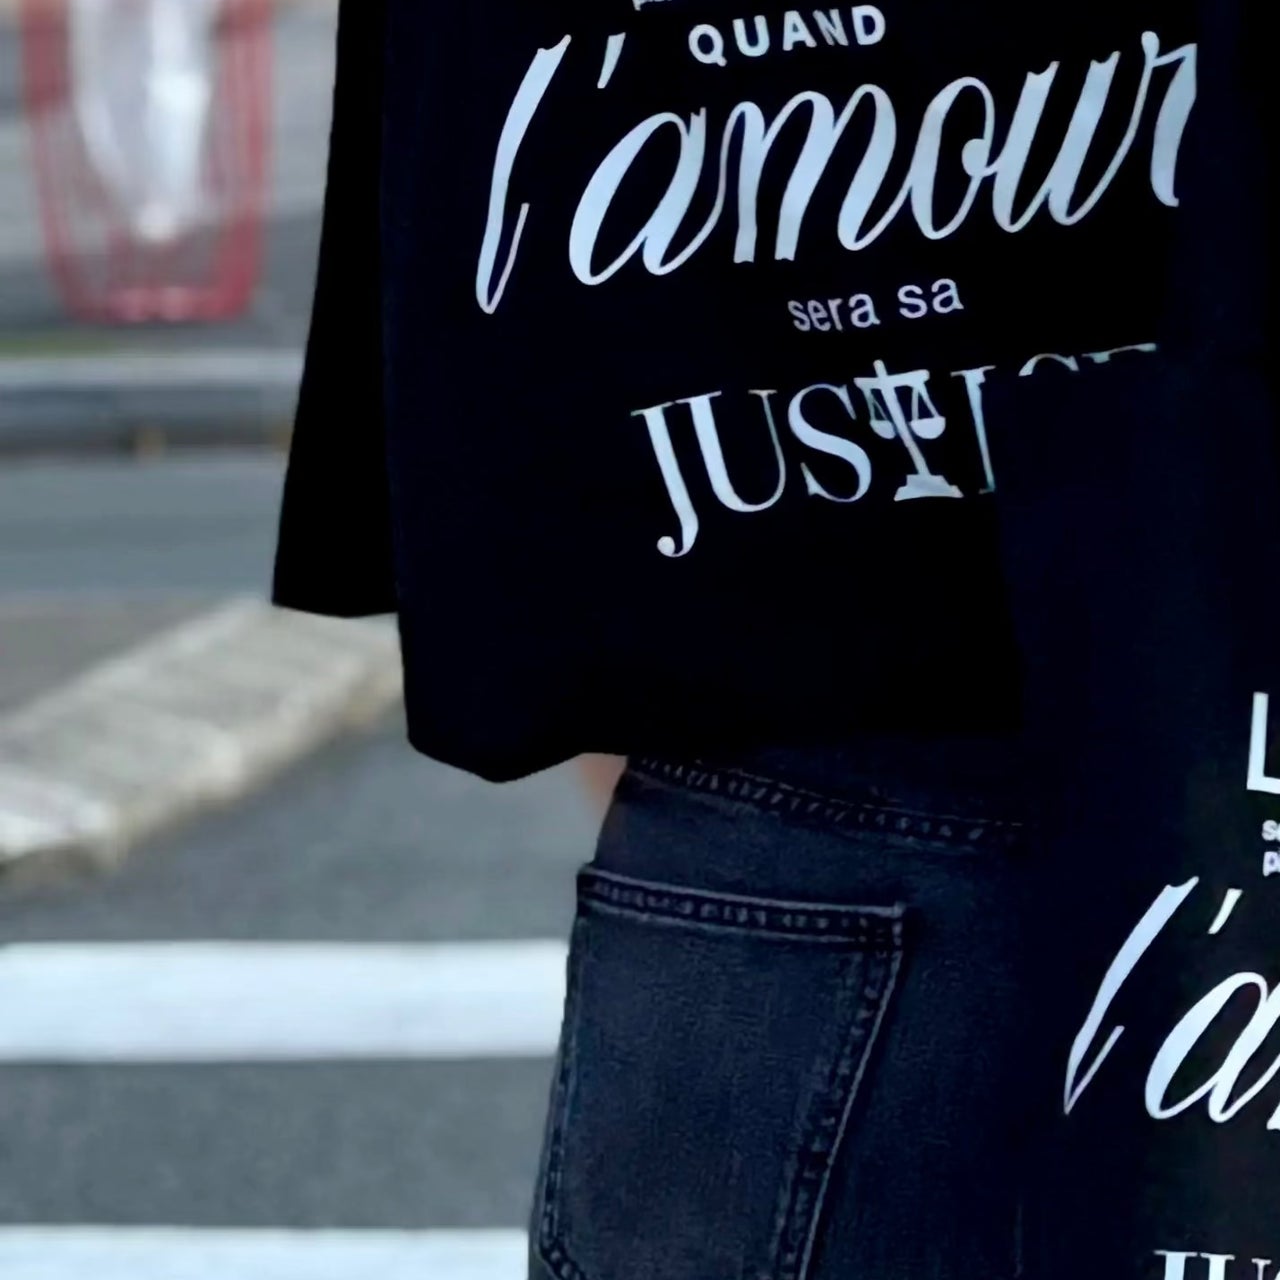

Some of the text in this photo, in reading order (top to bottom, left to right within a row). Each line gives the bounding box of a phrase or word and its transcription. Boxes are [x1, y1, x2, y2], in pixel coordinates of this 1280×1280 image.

[688, 4, 886, 67] QUAND
[475, 30, 1198, 315] l'amour
[788, 278, 964, 331] sera sa
[630, 342, 1157, 558] JUSTI
